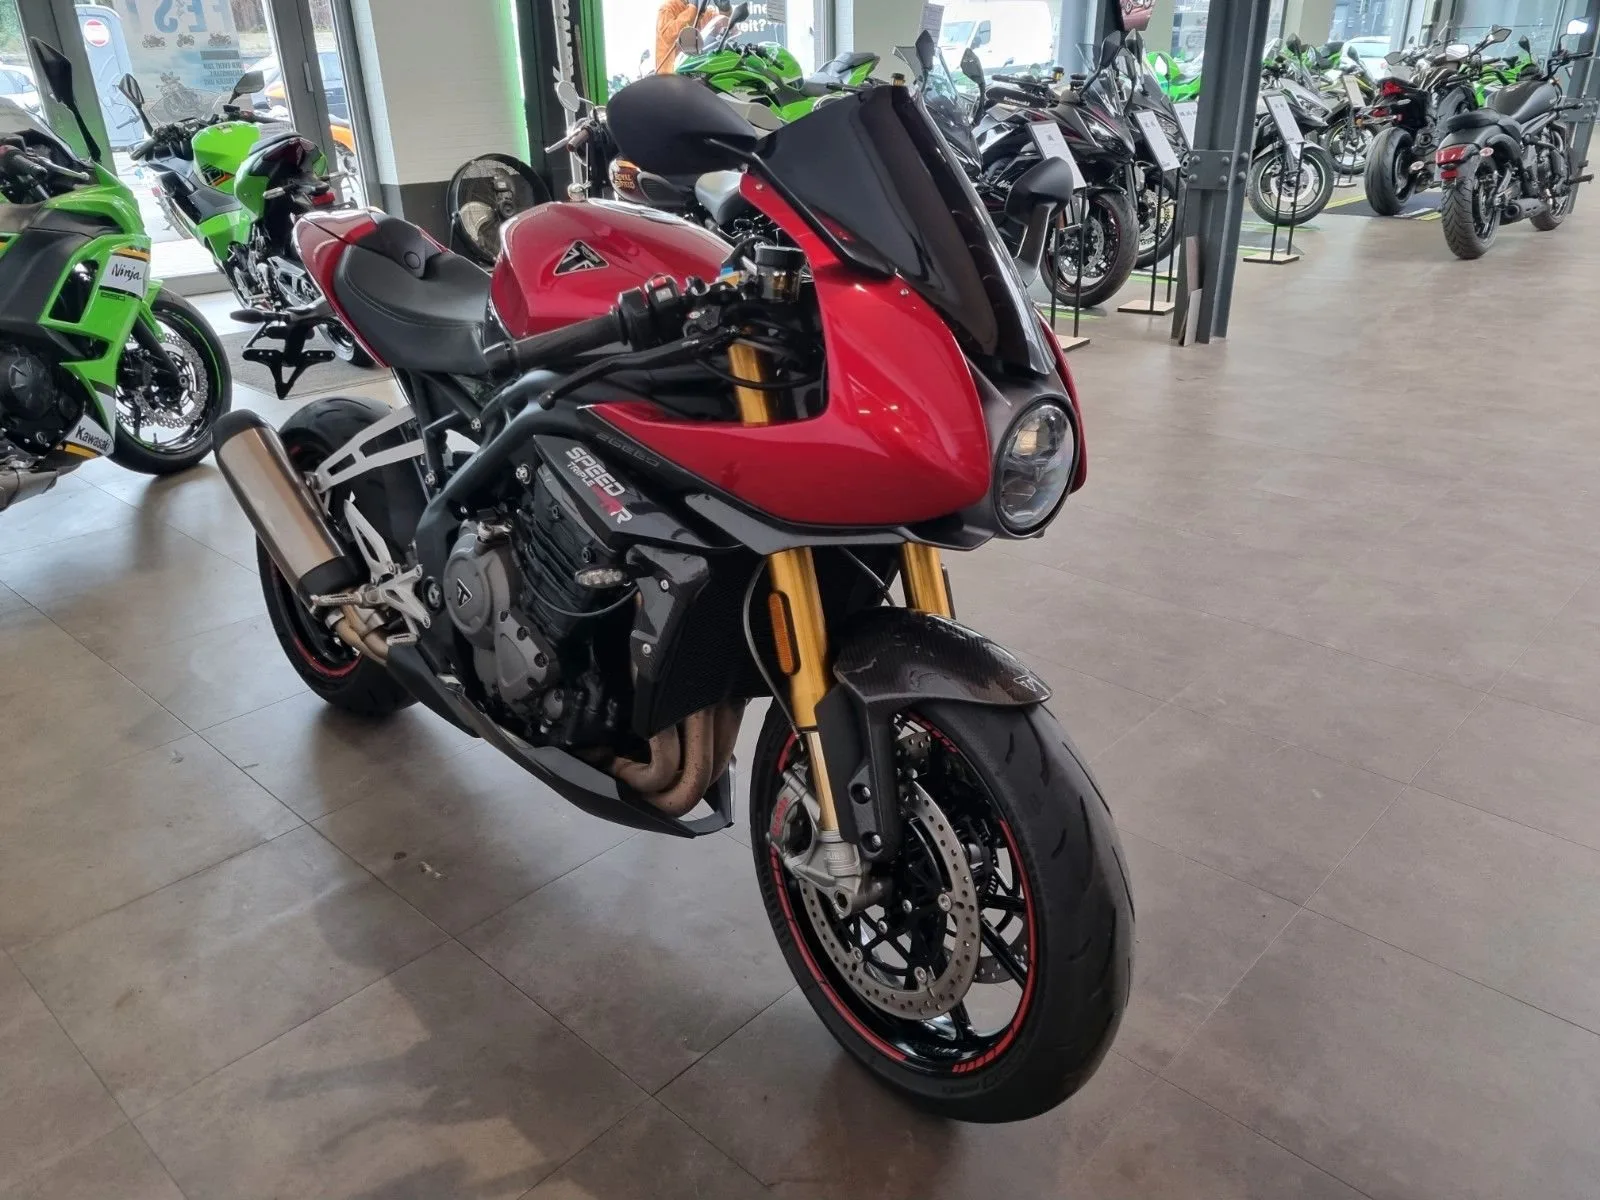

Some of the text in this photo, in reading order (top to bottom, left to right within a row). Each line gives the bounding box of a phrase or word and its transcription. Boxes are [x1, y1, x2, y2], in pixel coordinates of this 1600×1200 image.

[111, 263, 143, 284] Ninja
[75, 425, 111, 452] Kawasaki
[565, 446, 626, 497] SPEED
[567, 461, 595, 488] TRIPLE
